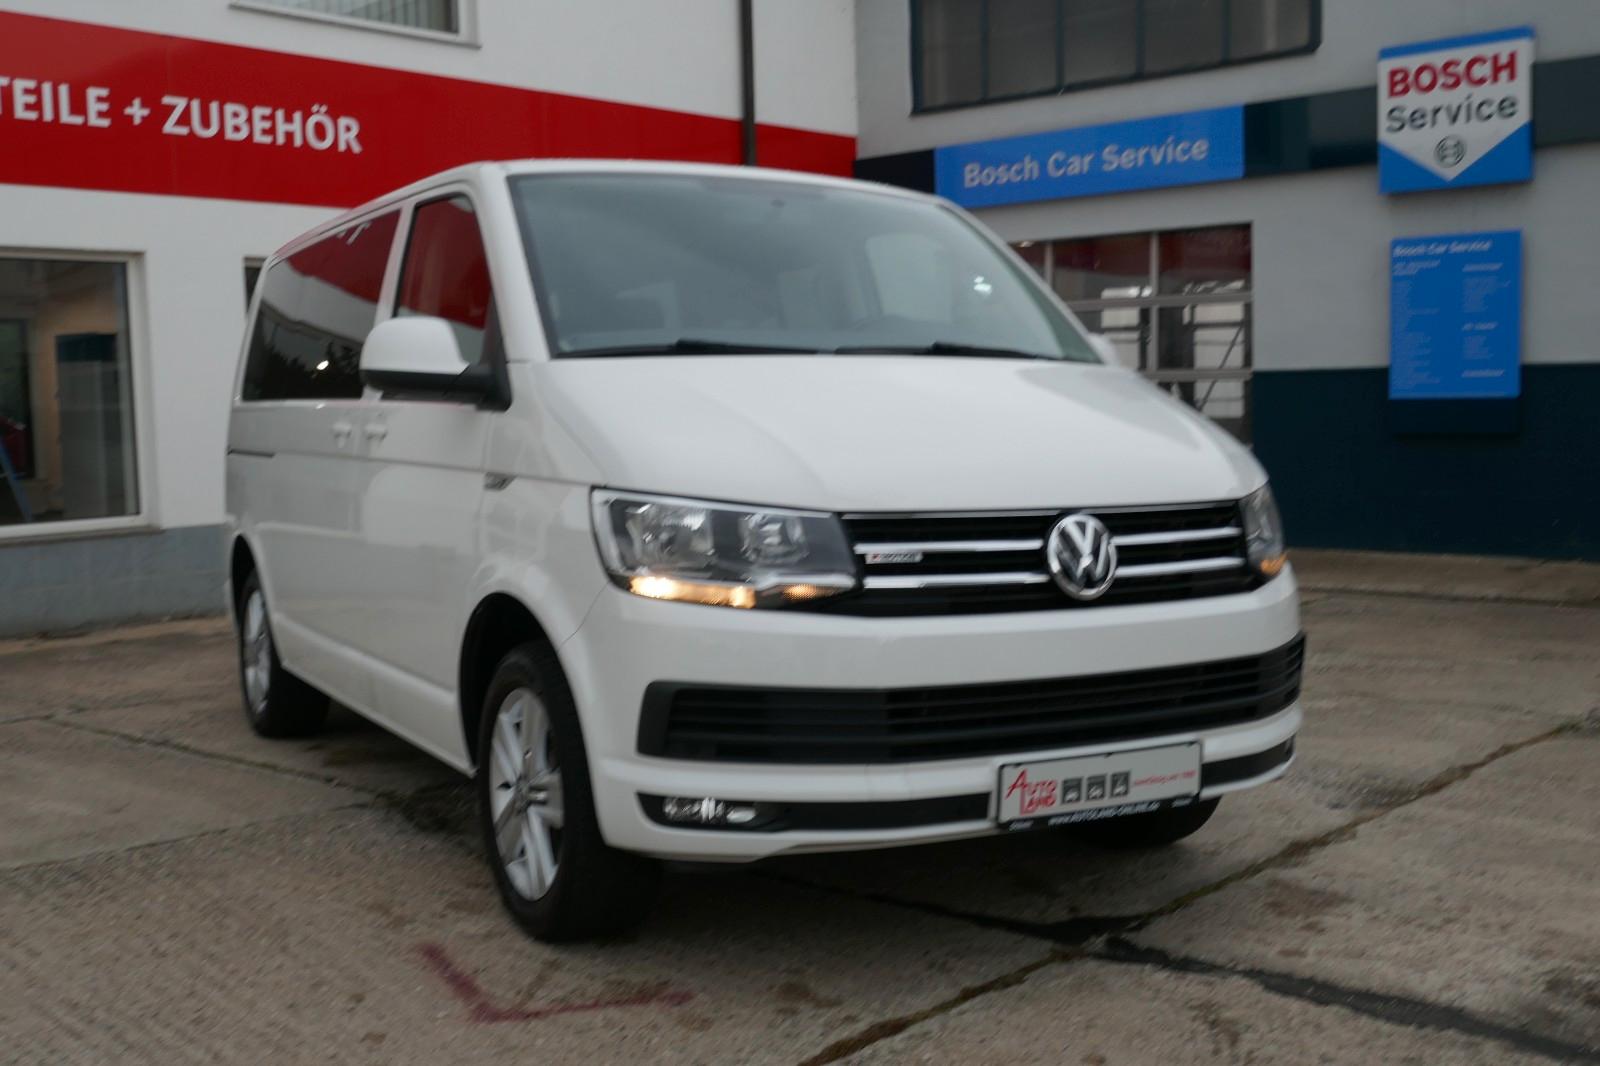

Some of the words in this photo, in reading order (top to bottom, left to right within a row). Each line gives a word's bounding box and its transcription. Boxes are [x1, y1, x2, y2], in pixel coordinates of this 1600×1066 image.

[1387, 49, 1518, 98] BOSCH
[161, 95, 363, 154] ZUBEHÖR
[1385, 92, 1519, 133] Service
[963, 155, 1040, 189] Bosch
[1047, 151, 1094, 178] Car
[1101, 135, 1210, 171] Service
